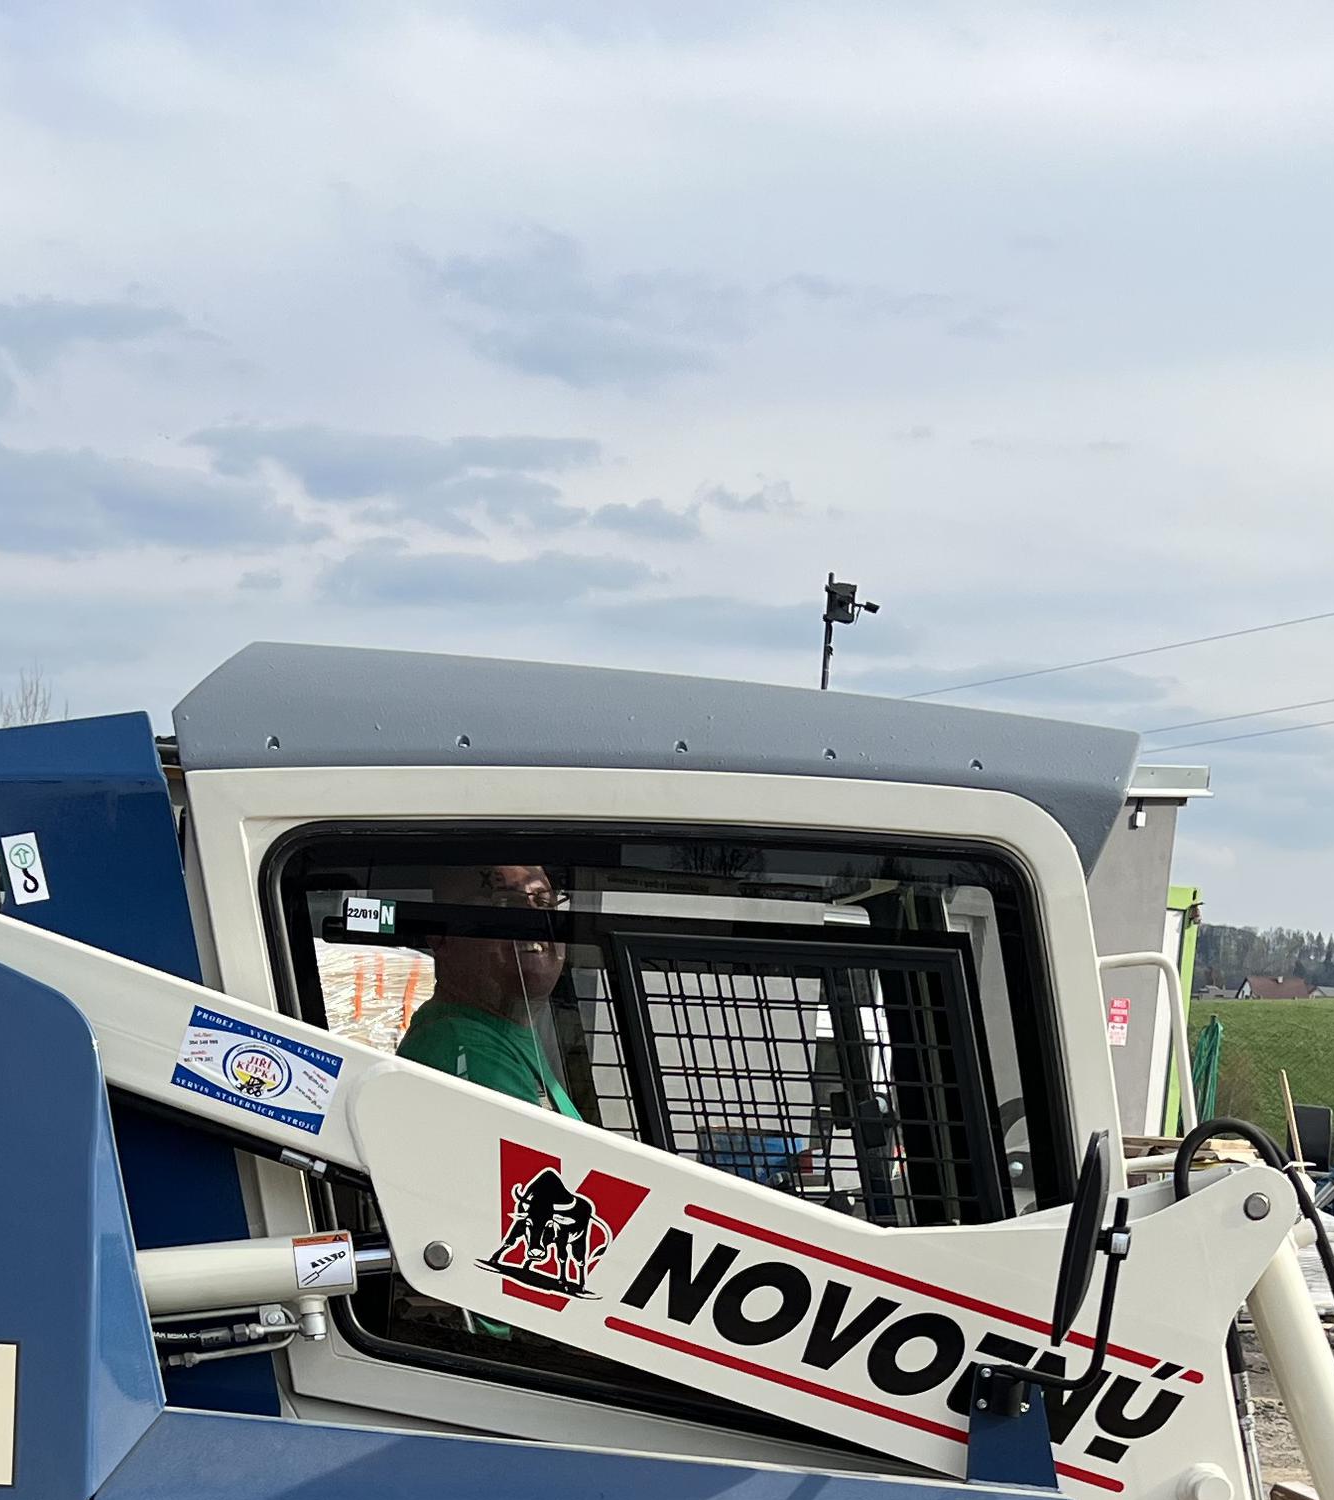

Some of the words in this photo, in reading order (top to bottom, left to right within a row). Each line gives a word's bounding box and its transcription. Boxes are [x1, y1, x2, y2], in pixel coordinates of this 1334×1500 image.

[195, 1009, 235, 1030] PRODEJ
[297, 1046, 339, 1067] LEASING
[235, 1060, 278, 1083] KUPKA
[175, 1076, 210, 1094] SERVIS
